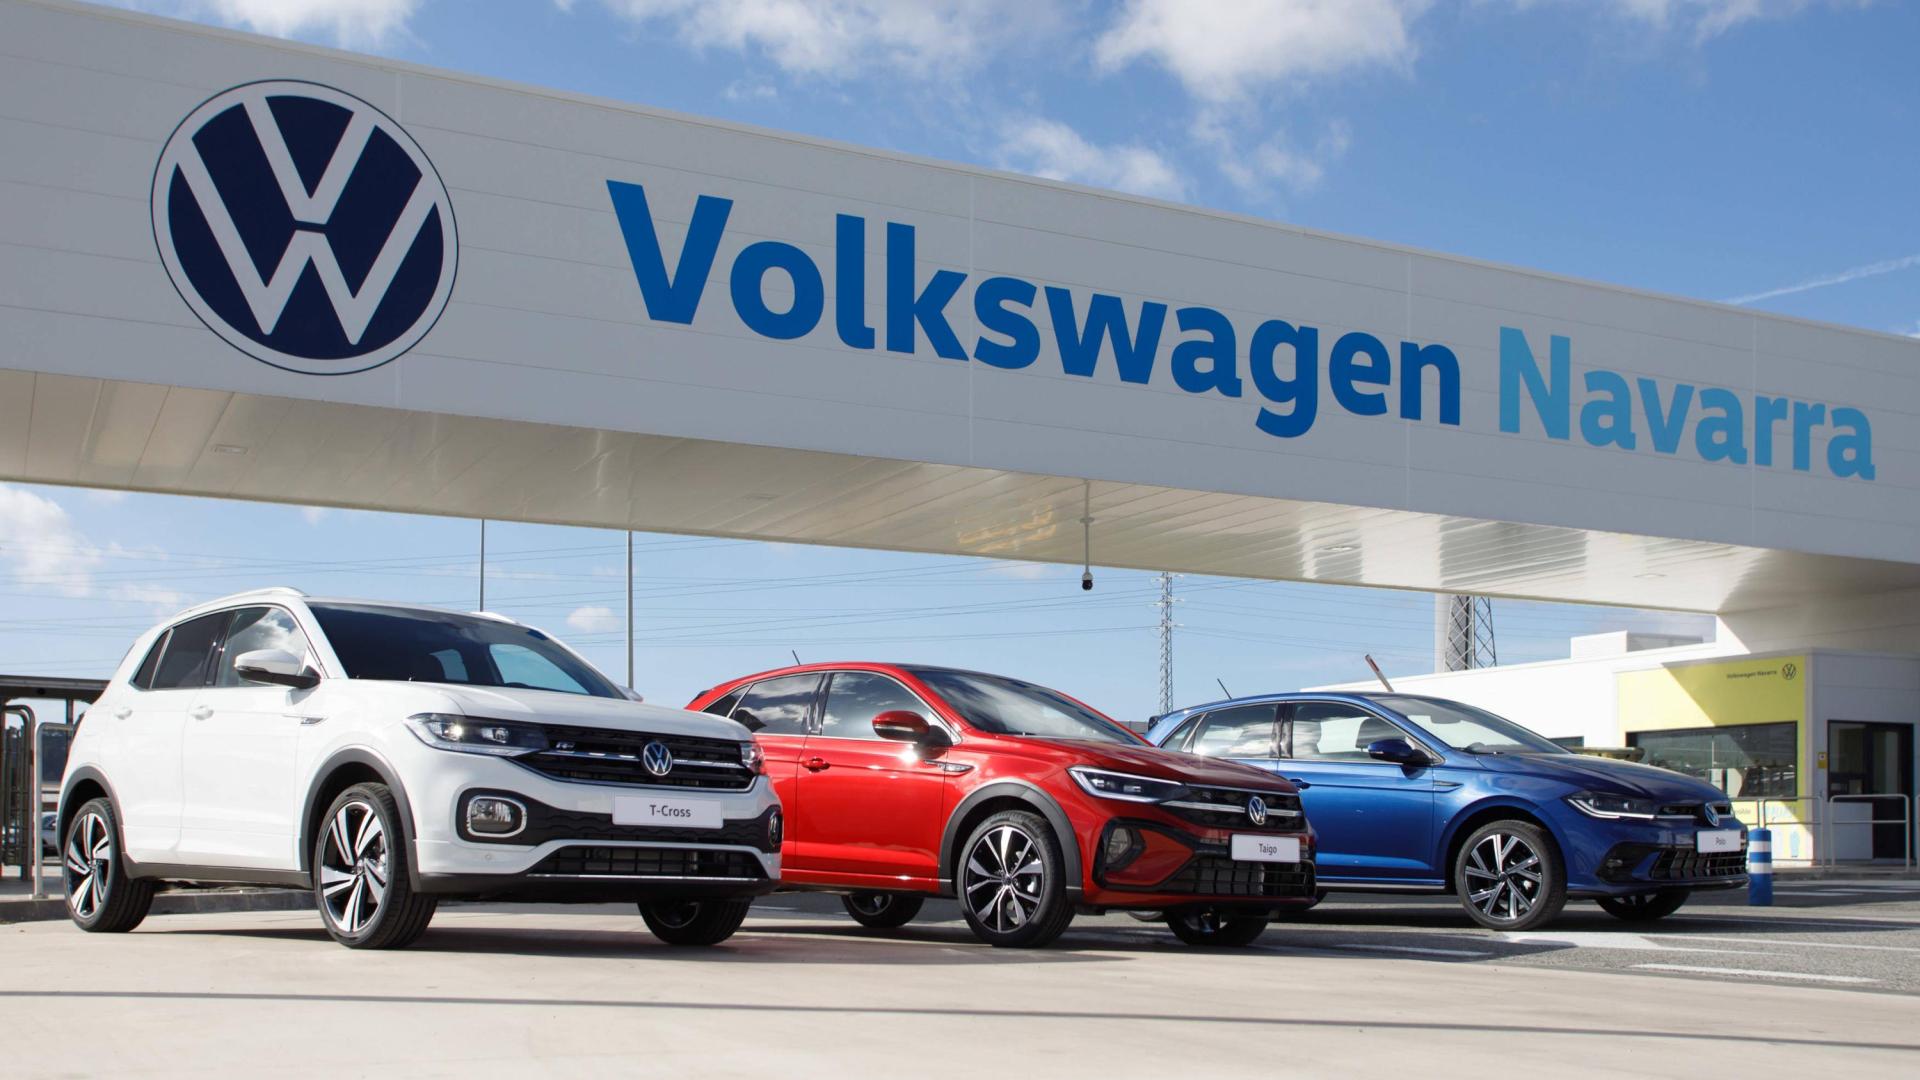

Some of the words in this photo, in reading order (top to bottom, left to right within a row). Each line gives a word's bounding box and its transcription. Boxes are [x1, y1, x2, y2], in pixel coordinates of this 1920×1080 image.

[606, 180, 1461, 438] Volkswagen
[1499, 326, 1876, 480] Navarra
[649, 804, 692, 818] T-Cross
[1258, 843, 1278, 855] Taigo
